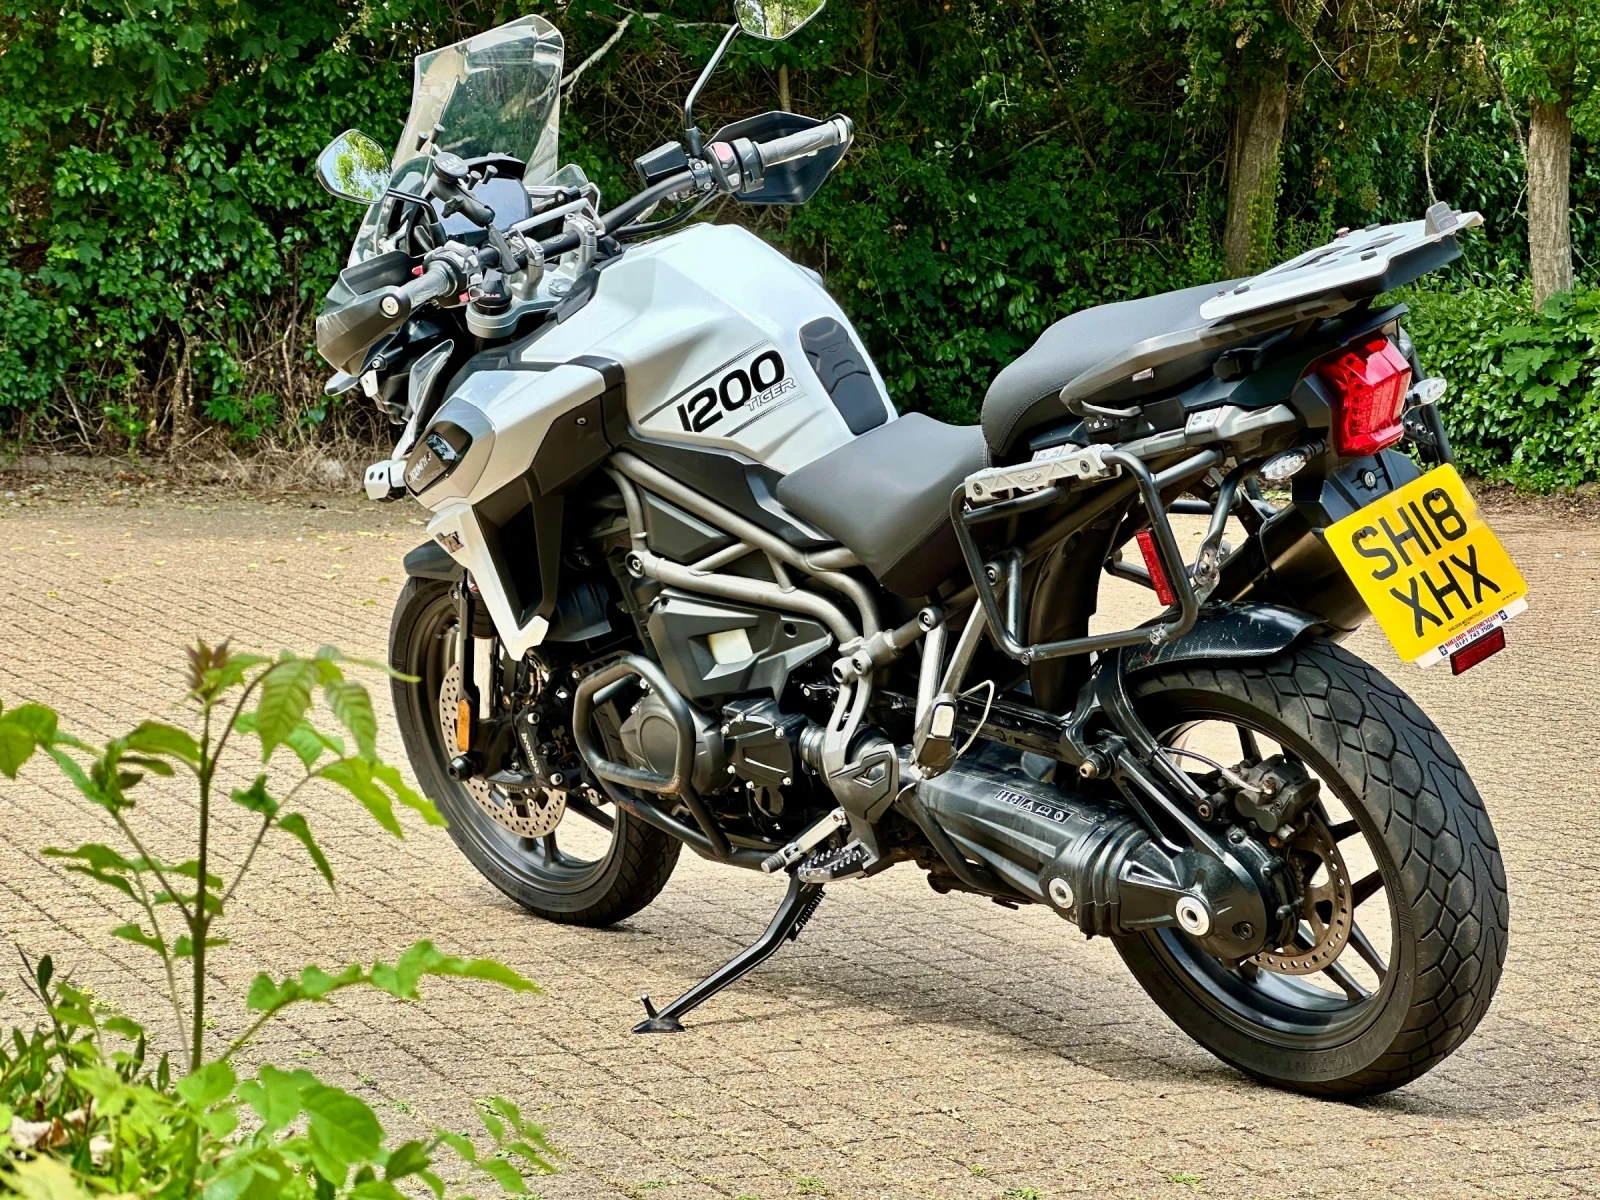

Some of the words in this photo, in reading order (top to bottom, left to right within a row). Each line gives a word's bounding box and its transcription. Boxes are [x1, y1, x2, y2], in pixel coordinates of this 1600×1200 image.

[676, 349, 785, 433] 1200
[743, 377, 796, 411] TIGER
[1351, 487, 1468, 581] SH18
[1389, 544, 1501, 638] XHX
[1444, 632, 1467, 647] SHELDON
[1466, 613, 1499, 634] MOTORCYCLES
[1448, 622, 1462, 632] SHELDON
[1462, 610, 1483, 625] MOTORCYCLES
[1454, 638, 1469, 649] 0121
[1469, 631, 1480, 640] 743
[1481, 623, 1494, 633] 3506
[521, 732, 540, 774] brembo
